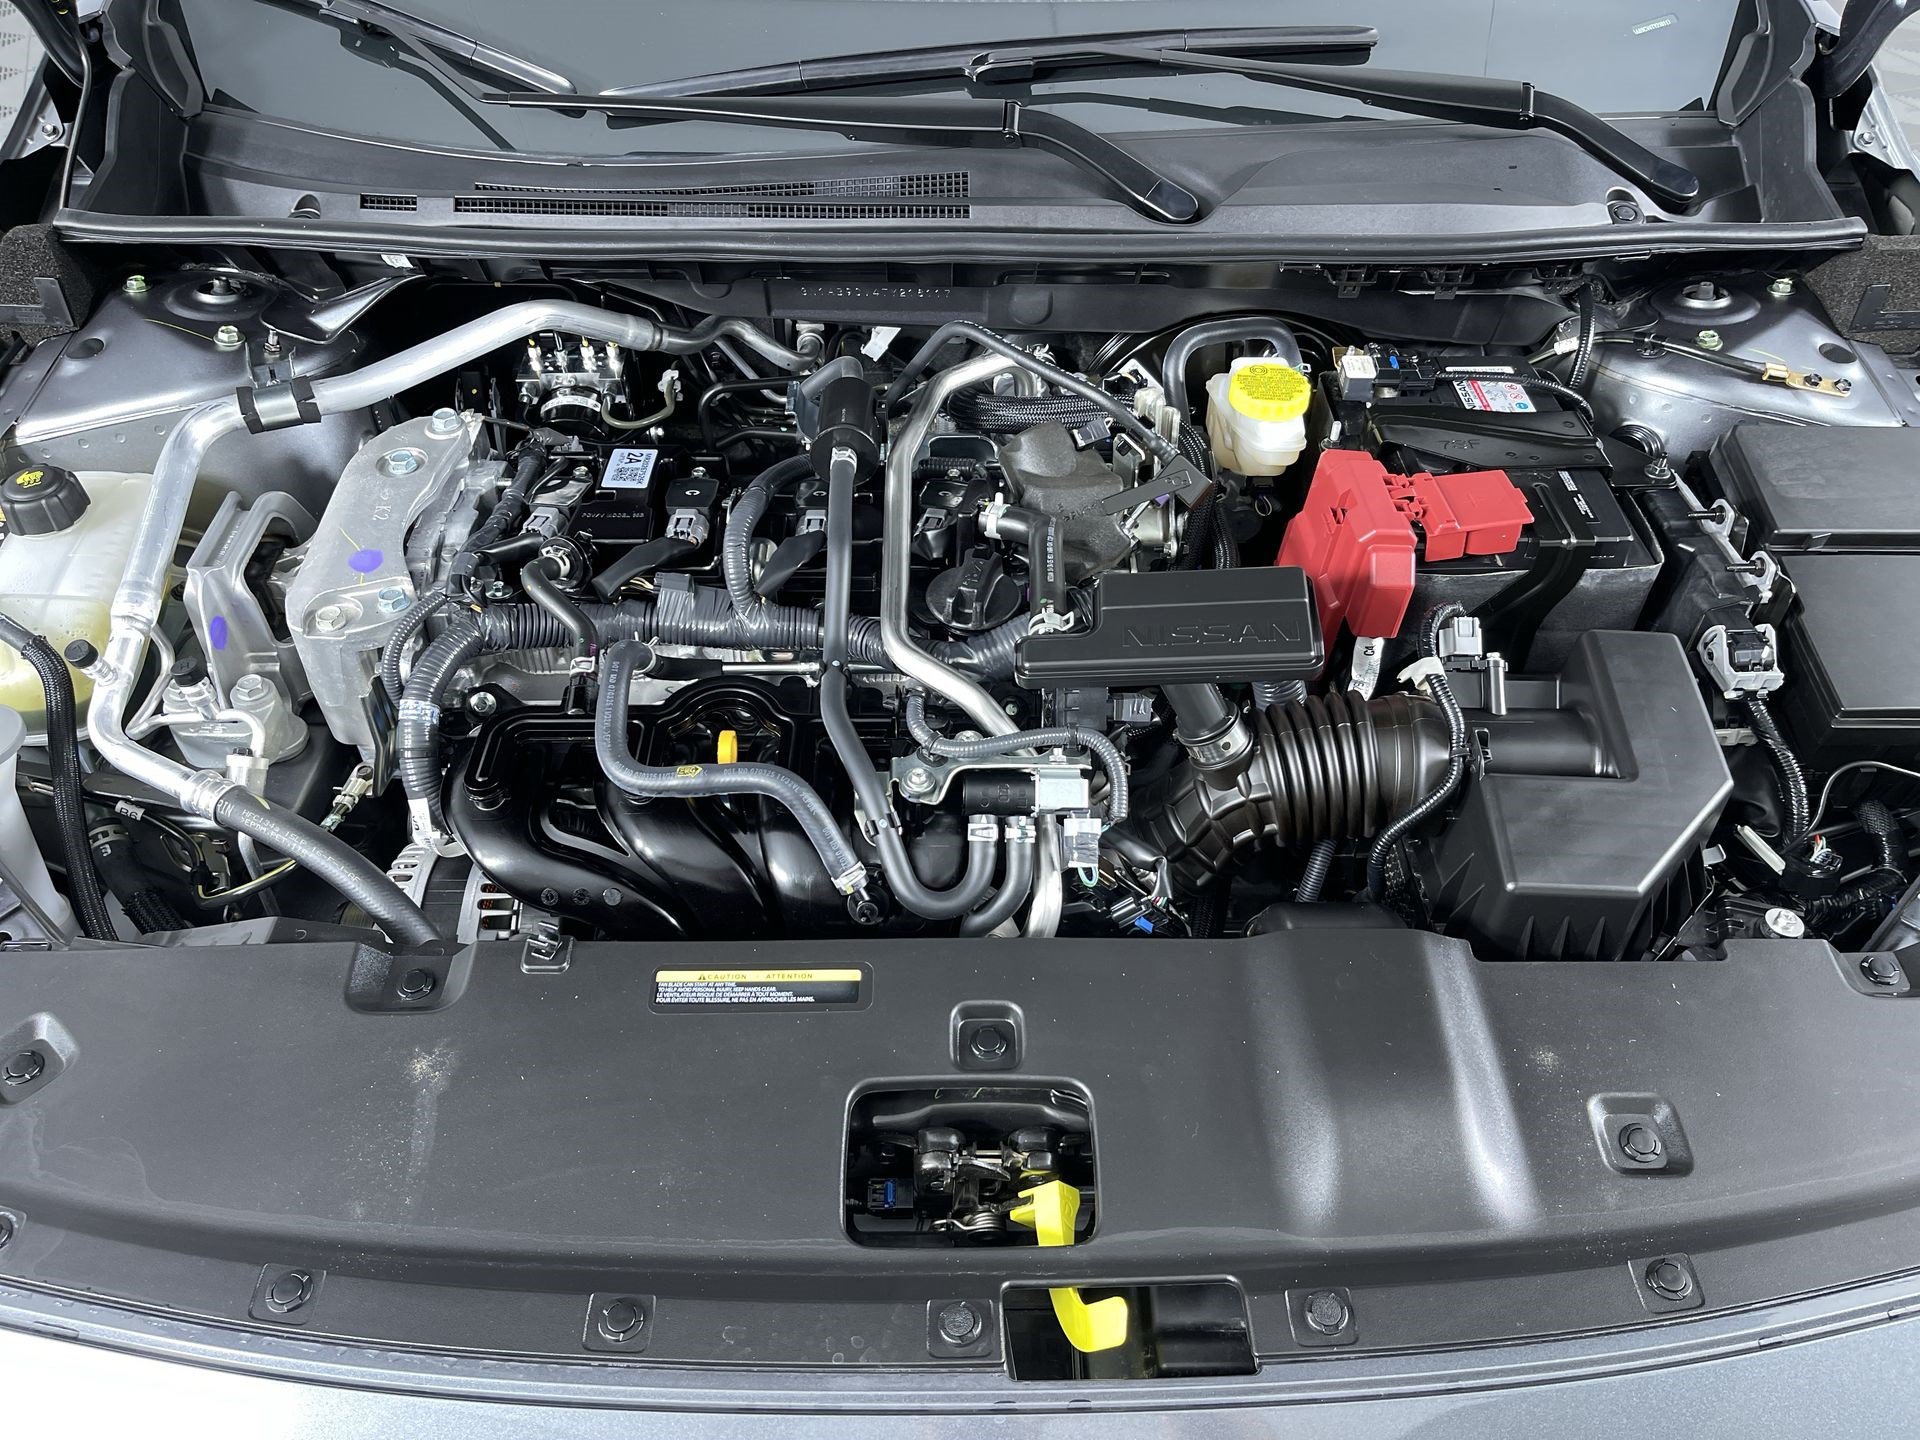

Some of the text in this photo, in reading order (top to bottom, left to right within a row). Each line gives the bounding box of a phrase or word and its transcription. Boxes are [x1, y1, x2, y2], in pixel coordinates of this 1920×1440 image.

[624, 452, 644, 465] 2A
[372, 505, 392, 521] K2
[1122, 619, 1302, 648] NISSAN
[119, 807, 138, 820] B6
[707, 973, 747, 981] CAUTION
